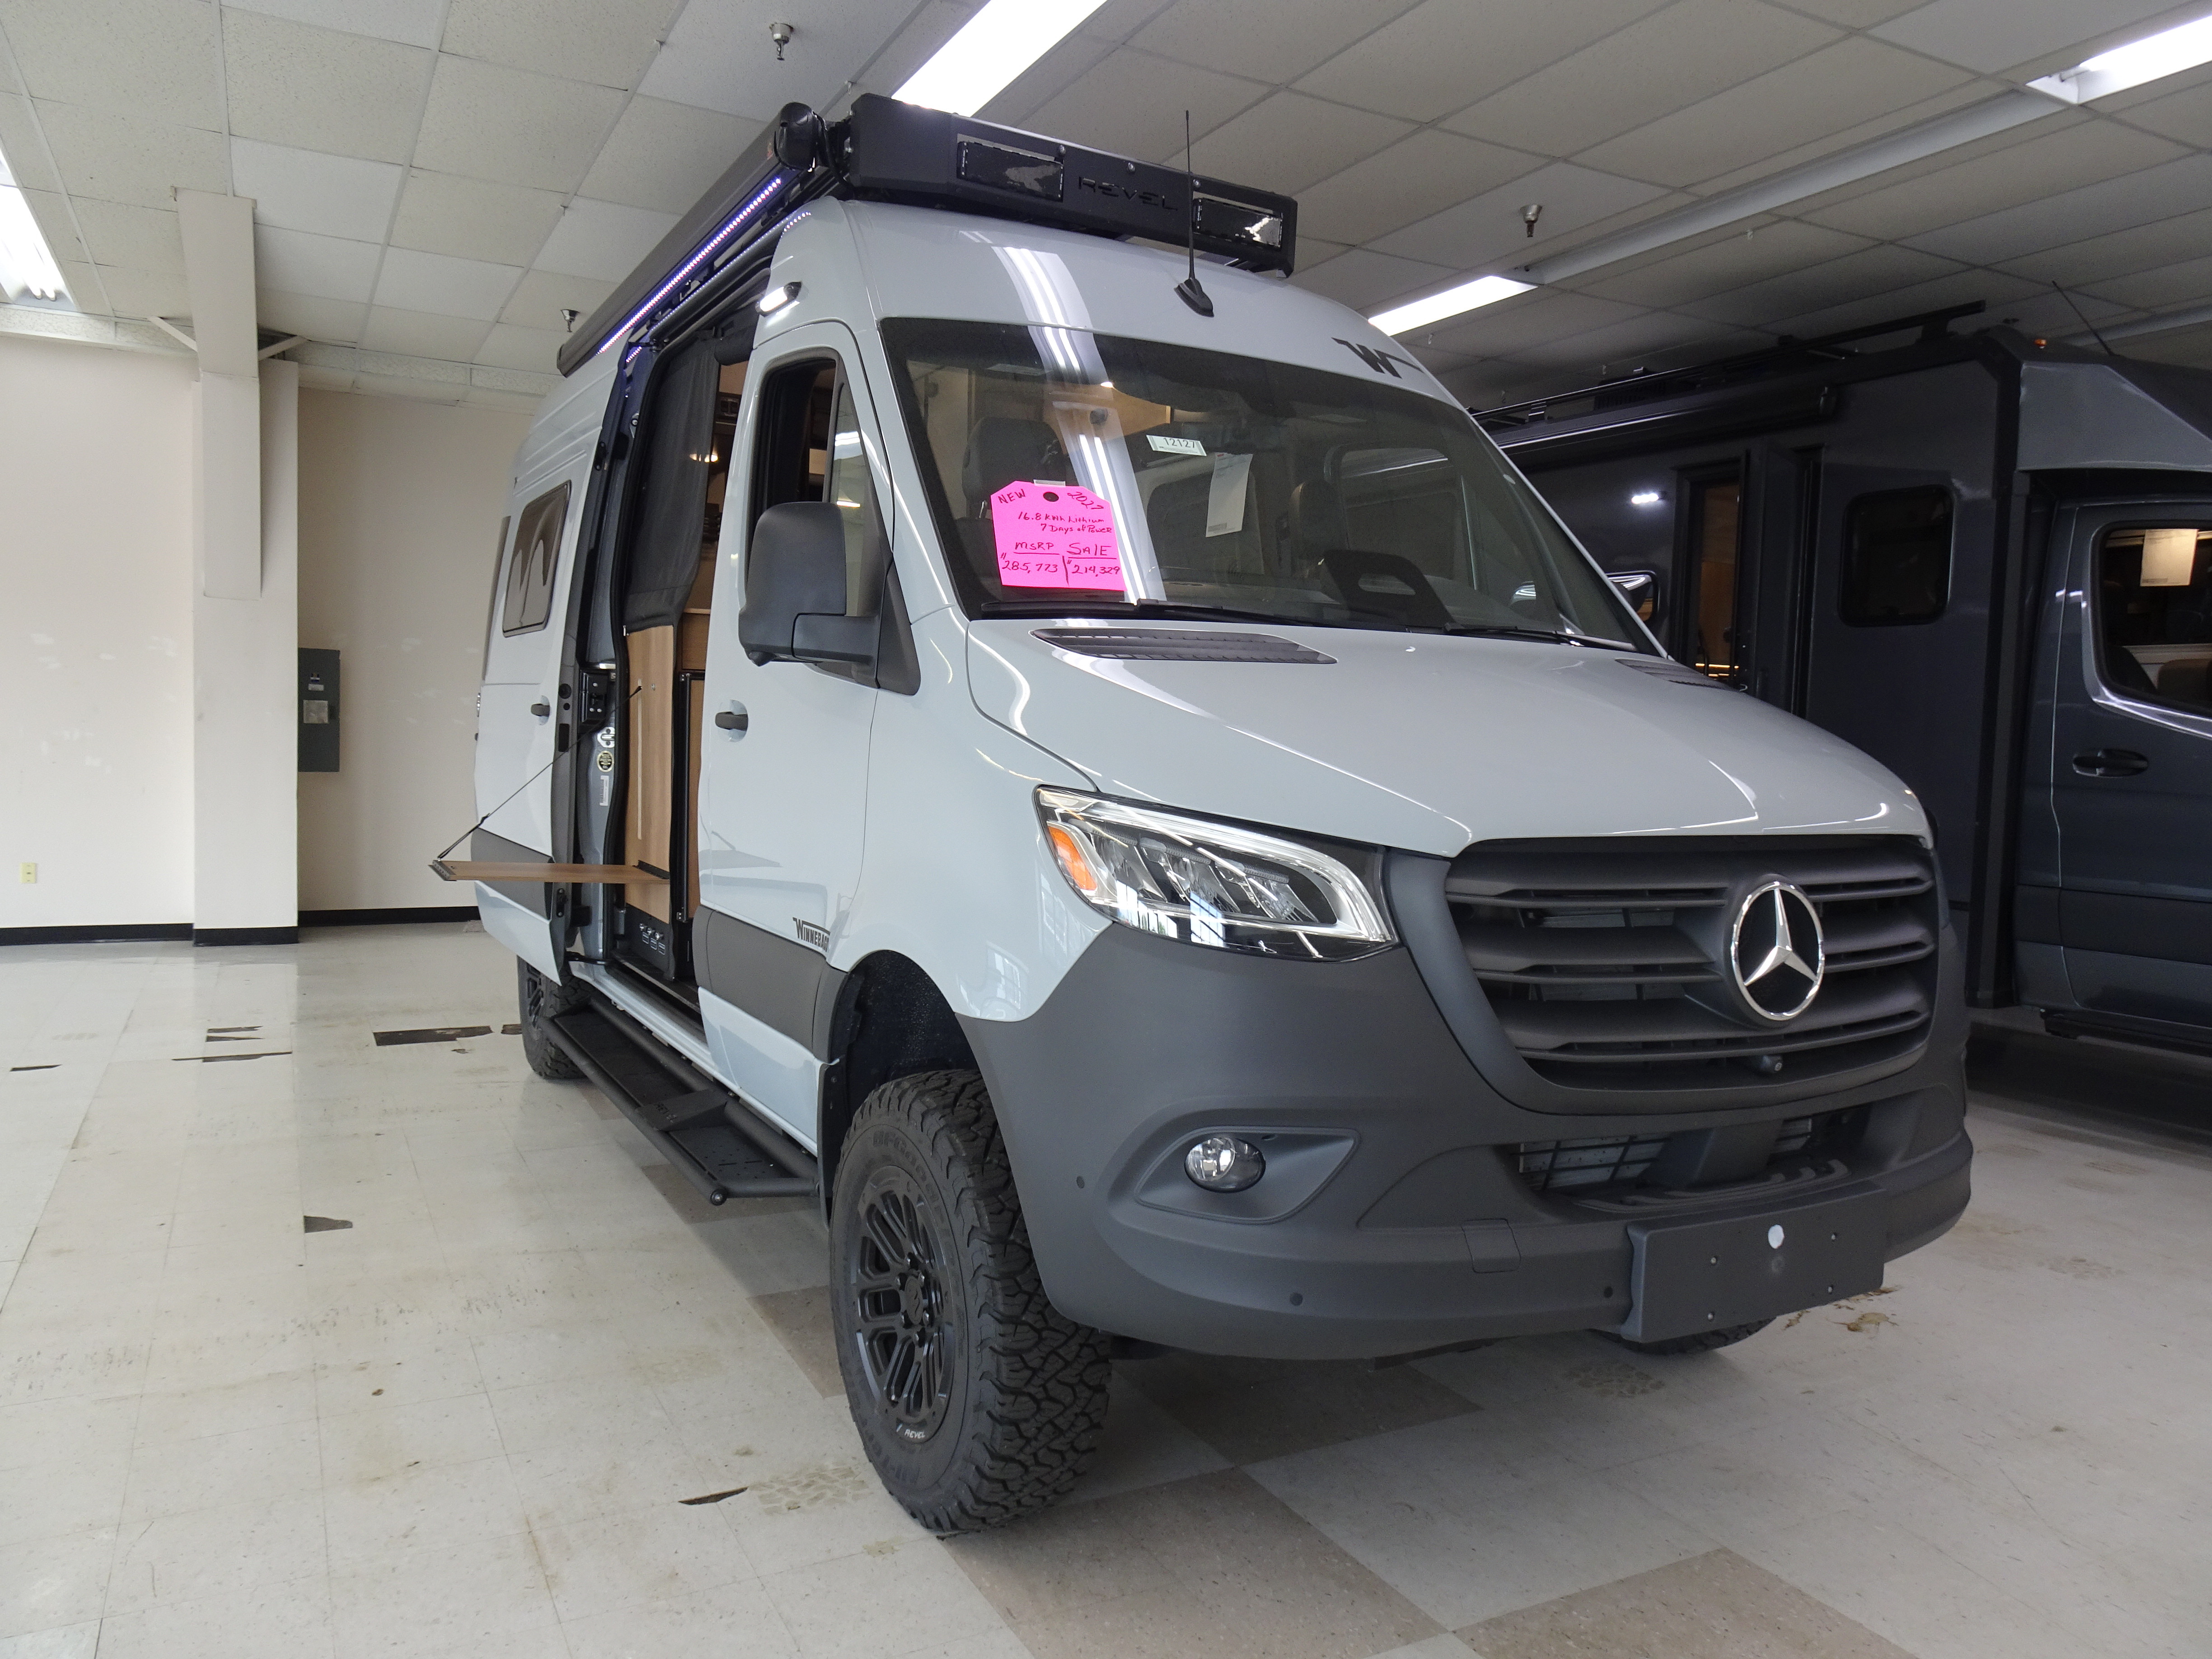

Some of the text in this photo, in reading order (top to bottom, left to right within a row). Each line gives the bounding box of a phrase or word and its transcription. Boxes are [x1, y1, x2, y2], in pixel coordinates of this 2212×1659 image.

[1078, 176, 1178, 211] REVEL
[1163, 437, 1195, 449] 12127
[997, 488, 1026, 504] NEW
[1018, 511, 1041, 520] 16.8
[1040, 523, 1047, 531] 7
[904, 1428, 926, 1439] REVEL
